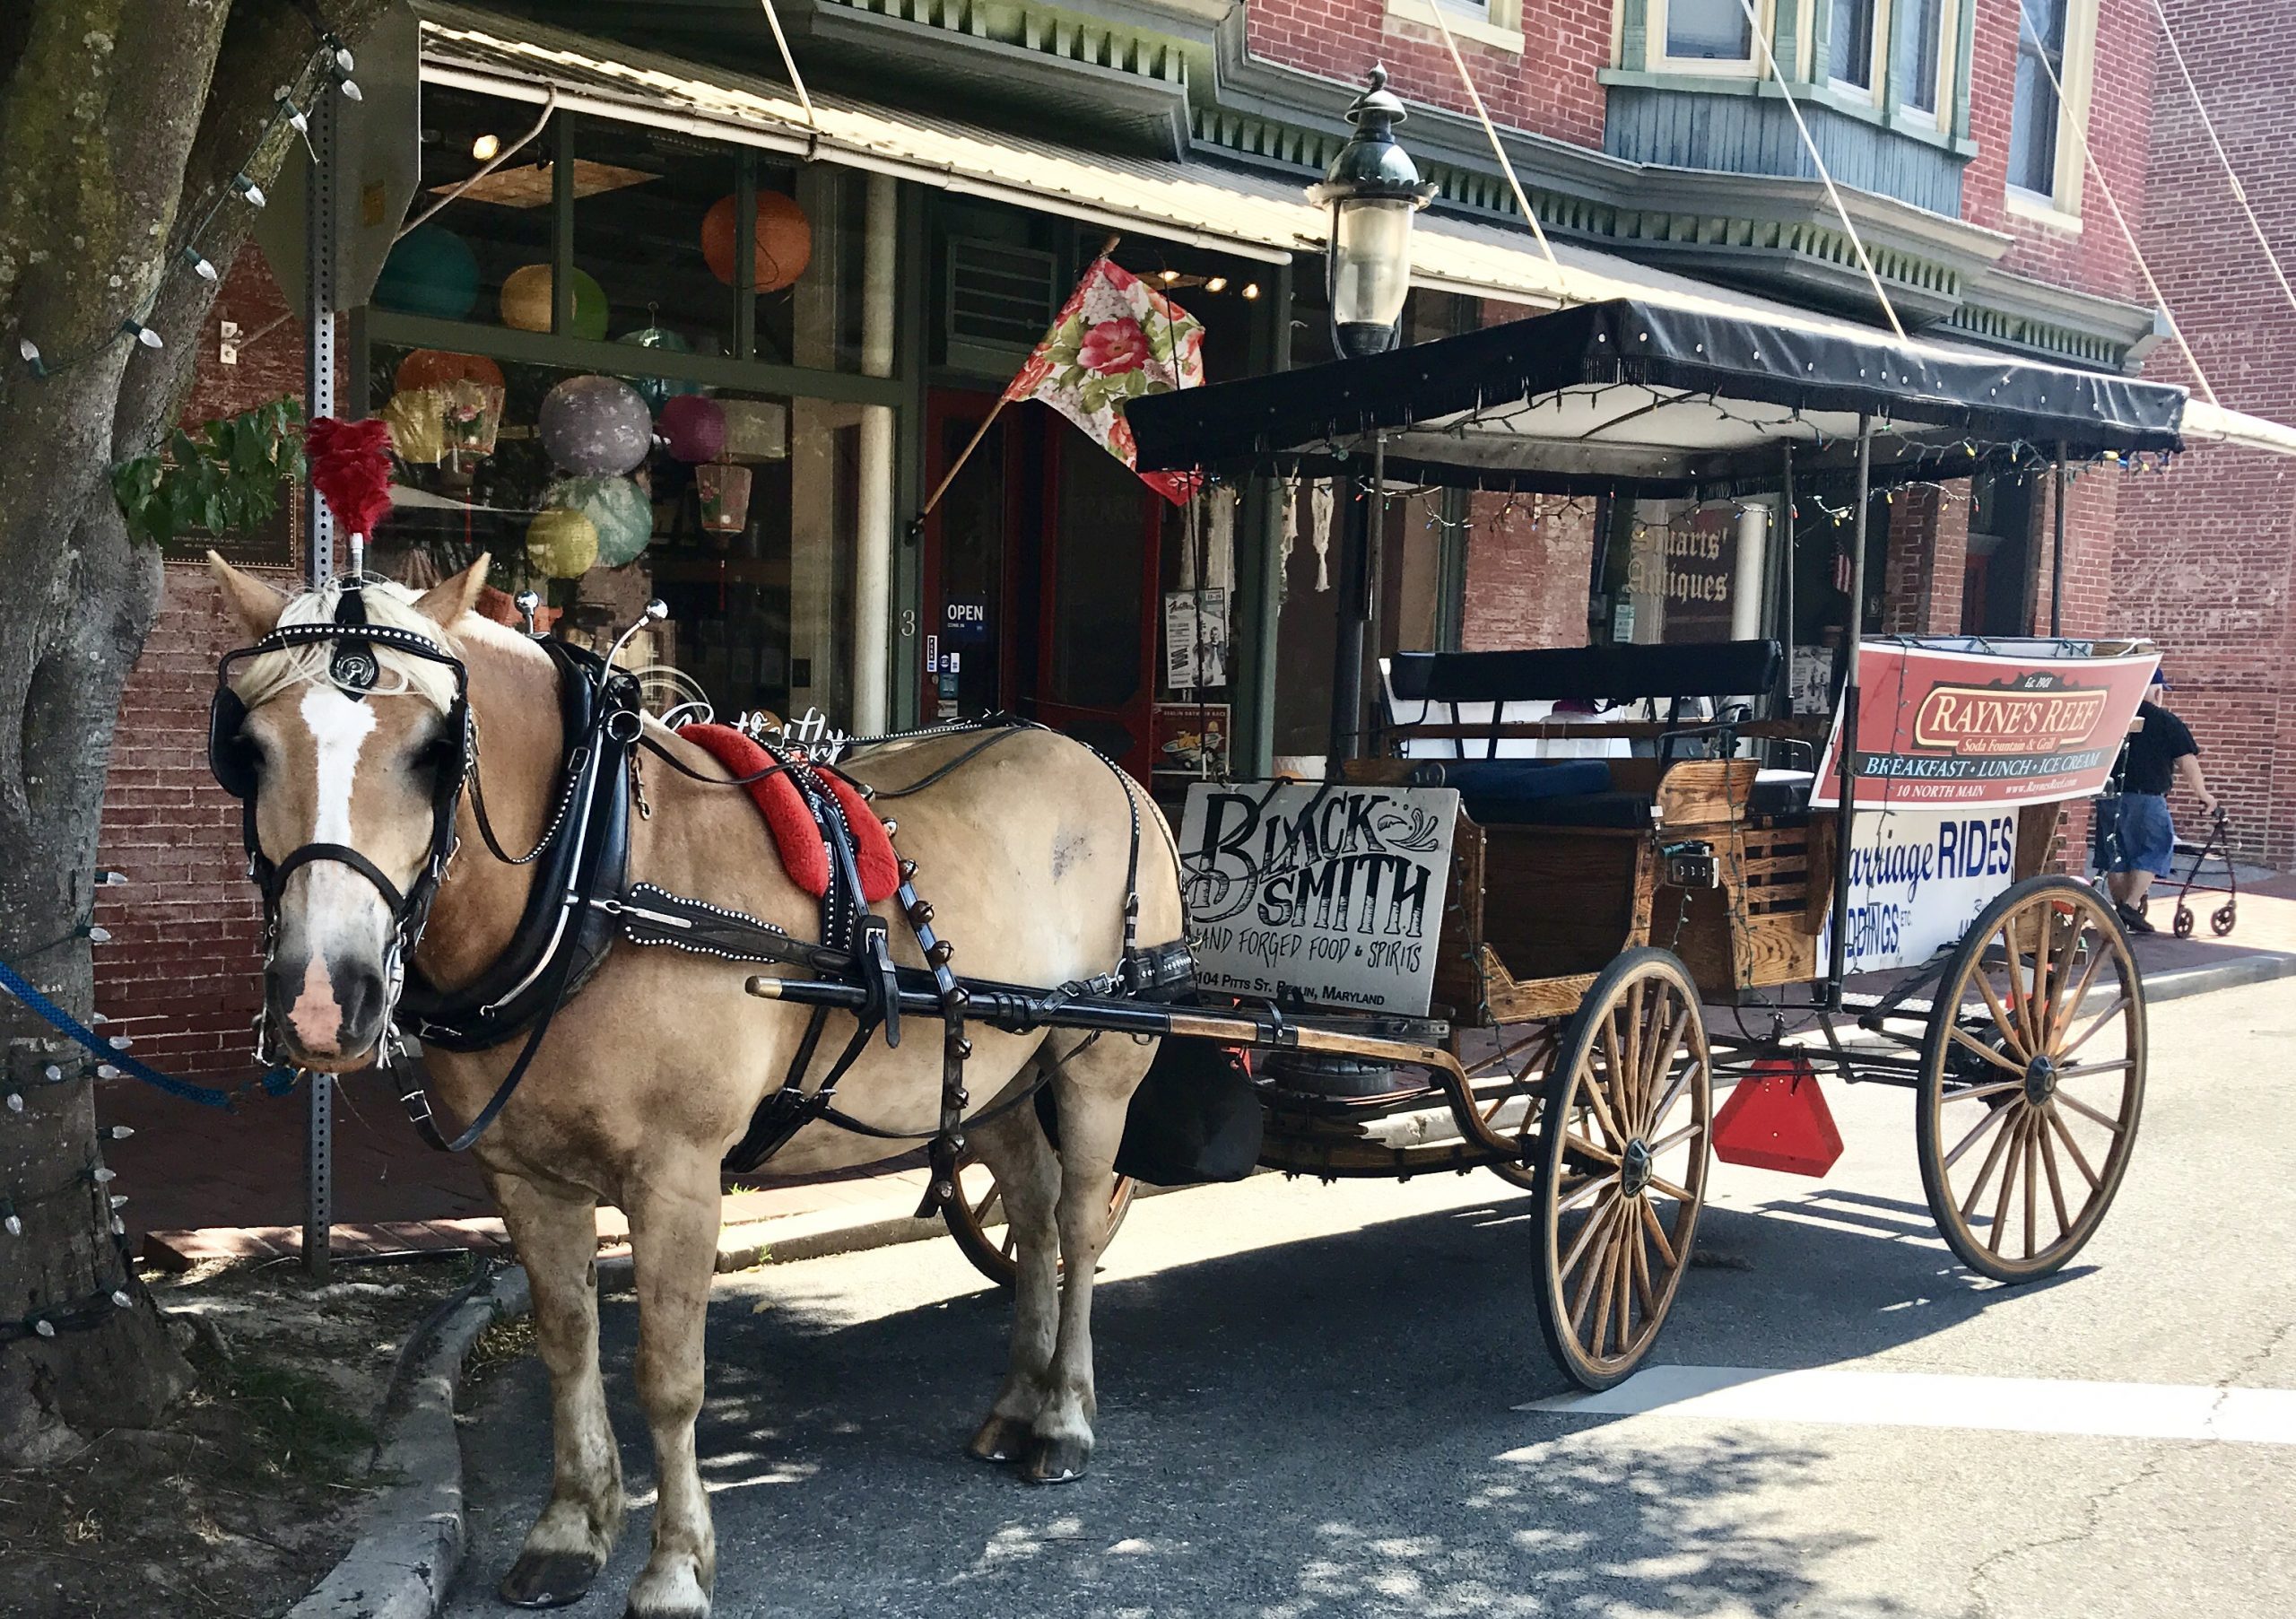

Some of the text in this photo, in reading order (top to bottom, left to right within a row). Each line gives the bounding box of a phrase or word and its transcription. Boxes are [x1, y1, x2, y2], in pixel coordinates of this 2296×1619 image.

[901, 610, 916, 636] 3
[947, 605, 983, 621] OPEN
[1929, 695, 2100, 734] RAYNE'S REEF
[1962, 736, 2057, 753] Soda Fountain & Grill
[1864, 752, 2102, 778] BREAKFAST LUNCH ICE CREAM
[1896, 785, 1987, 797] 10 NORTH MAIN
[2005, 777, 2078, 795] www.RaynesReef.com
[1186, 790, 1391, 923] BLACK
[1848, 829, 1935, 903] arriage
[1257, 852, 1431, 938] SMITH
[1194, 926, 1422, 976] AND FORGED FOOD & SPIRITS
[1197, 971, 1219, 986] 104
